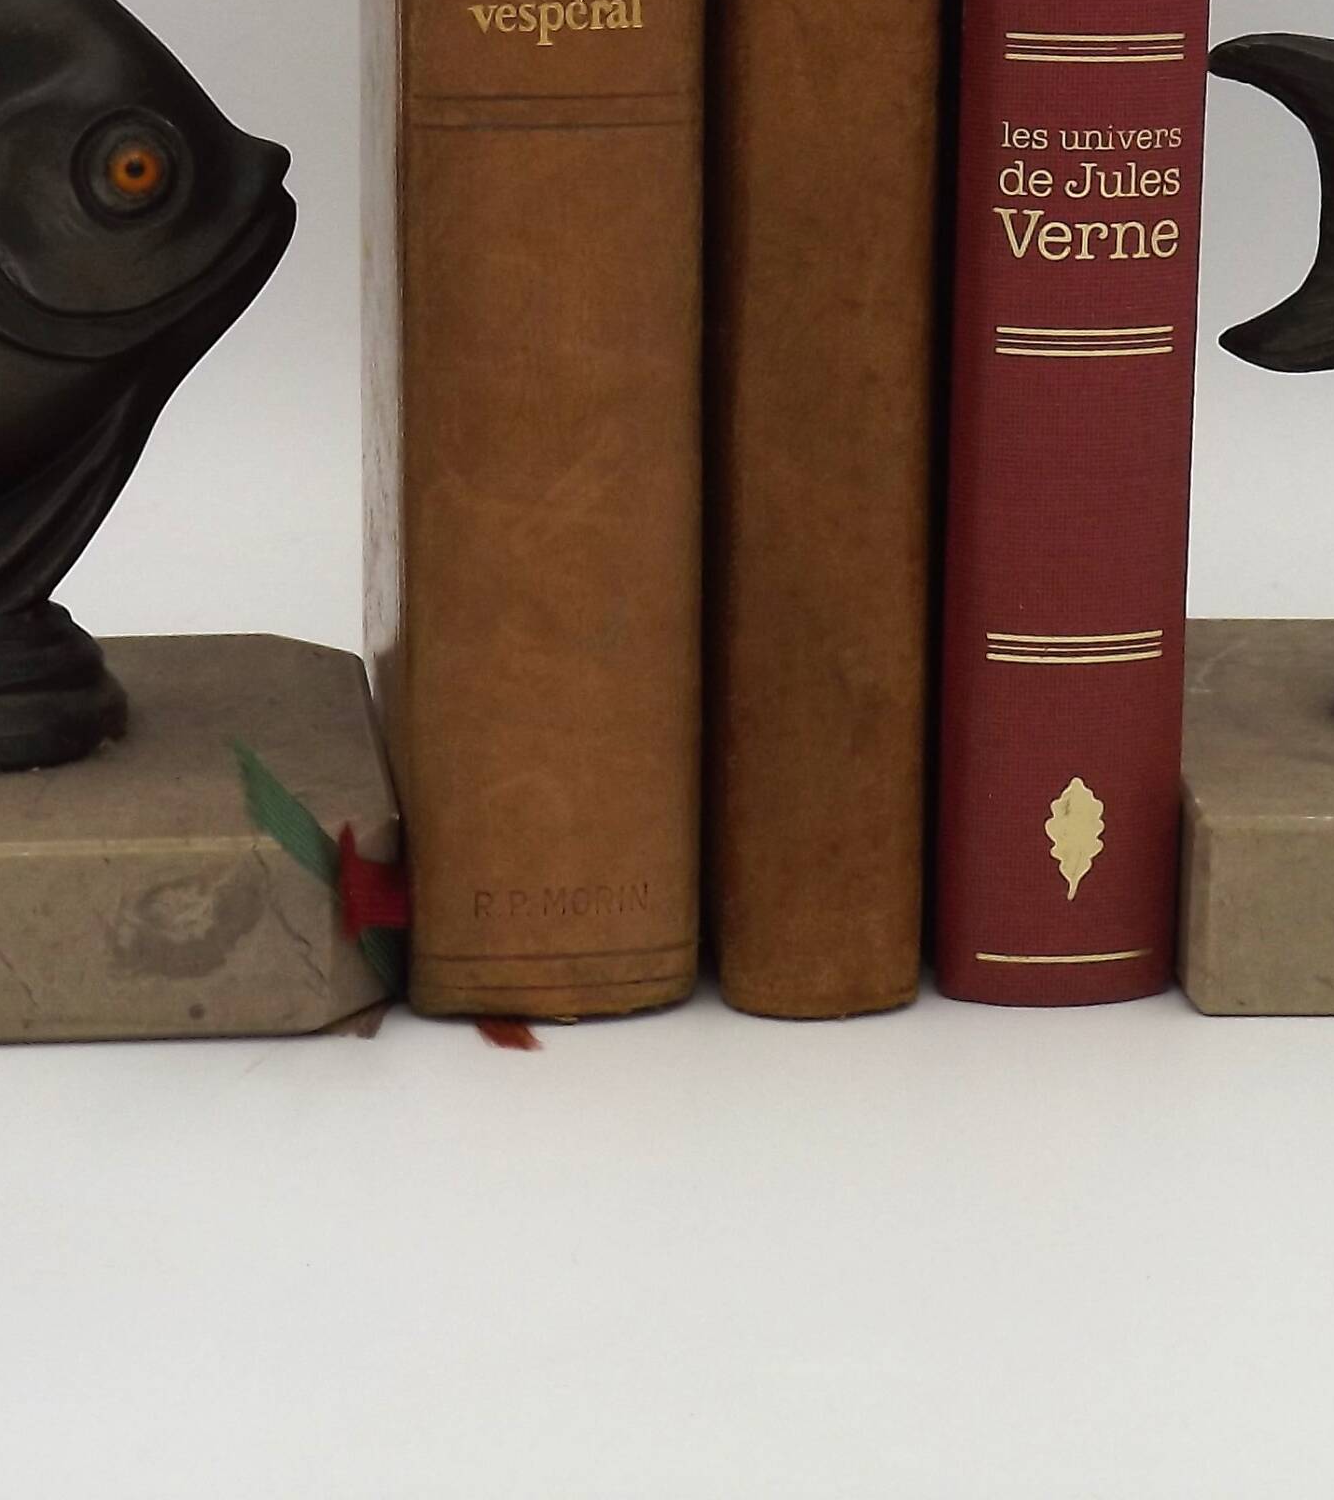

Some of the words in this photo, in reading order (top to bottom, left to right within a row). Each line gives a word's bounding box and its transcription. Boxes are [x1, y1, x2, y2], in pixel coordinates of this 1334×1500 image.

[1001, 121, 1049, 150] les
[1059, 124, 1182, 151] univers
[999, 160, 1053, 198] de
[1064, 162, 1182, 199] Jules
[992, 206, 1179, 261] Verne
[542, 881, 649, 917] MORIN
